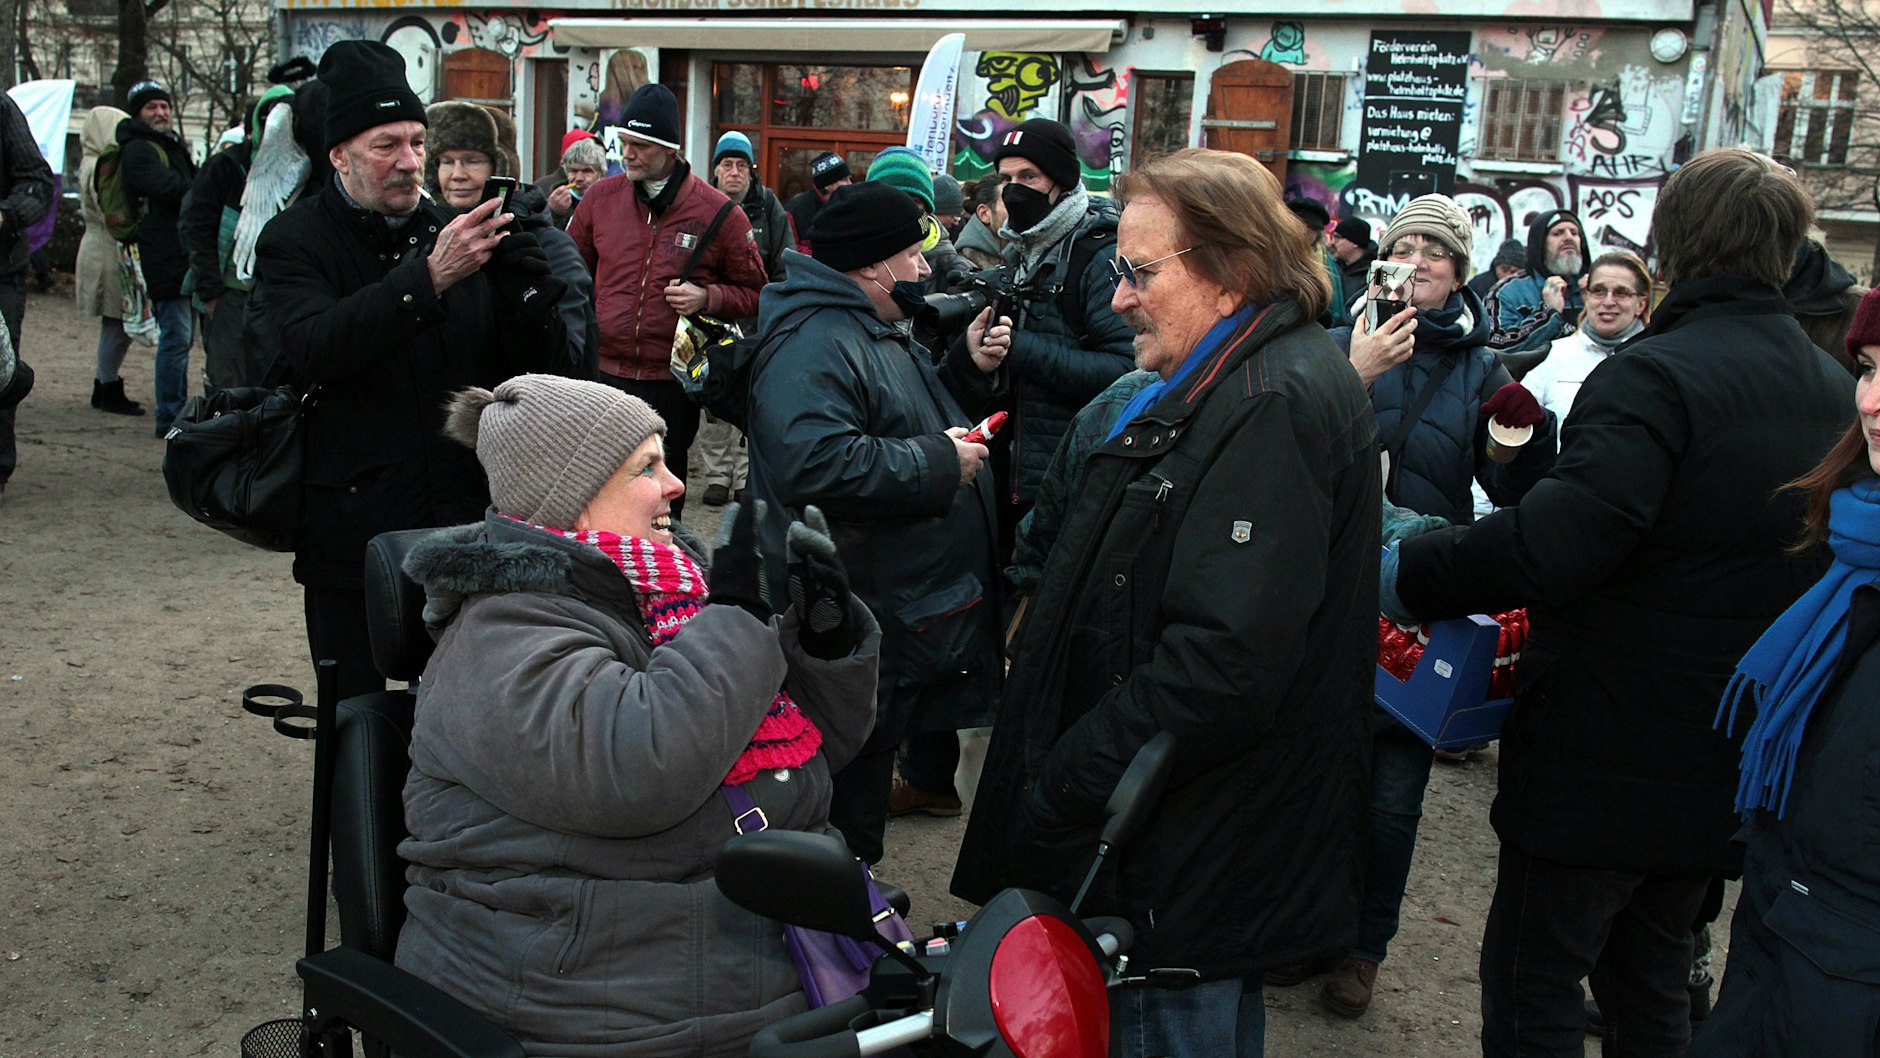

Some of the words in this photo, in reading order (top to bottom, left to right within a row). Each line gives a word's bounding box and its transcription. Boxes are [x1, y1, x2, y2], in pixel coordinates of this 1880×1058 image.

[1373, 38, 1437, 53] Förderverein
[1367, 106, 1388, 119] Das
[1390, 105, 1414, 120] Haus
[1416, 108, 1456, 122] mieten:
